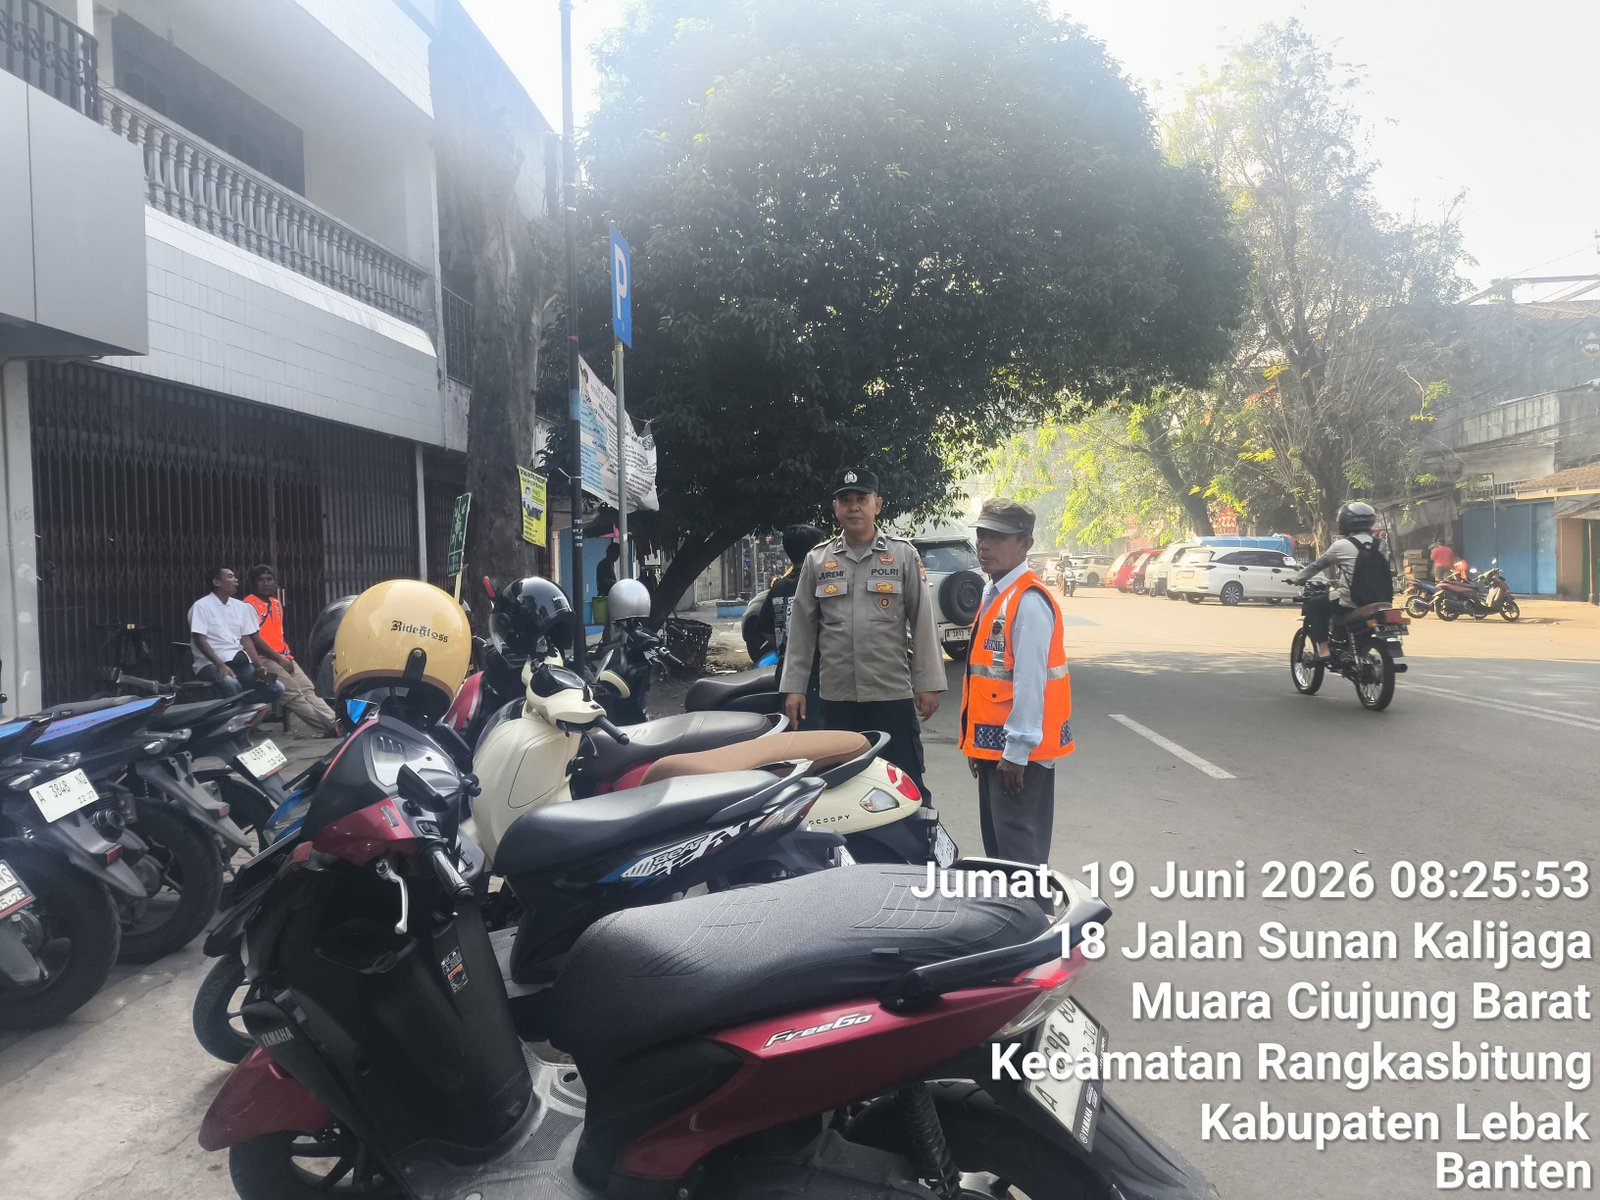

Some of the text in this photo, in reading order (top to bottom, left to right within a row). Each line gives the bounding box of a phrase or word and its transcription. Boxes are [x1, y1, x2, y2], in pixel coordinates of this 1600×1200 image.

[614, 243, 628, 320] P
[819, 571, 845, 580] JUREMI
[871, 568, 899, 576] POLRI
[36, 790, 46, 804] A
[49, 780, 71, 798] 3848
[809, 814, 850, 825] SCOOPY
[262, 1026, 295, 1047] YAMAHA
[765, 1013, 872, 1048] FreeGo
[1035, 1085, 1058, 1112] A
[1080, 1106, 1094, 1137] YAMAHA
